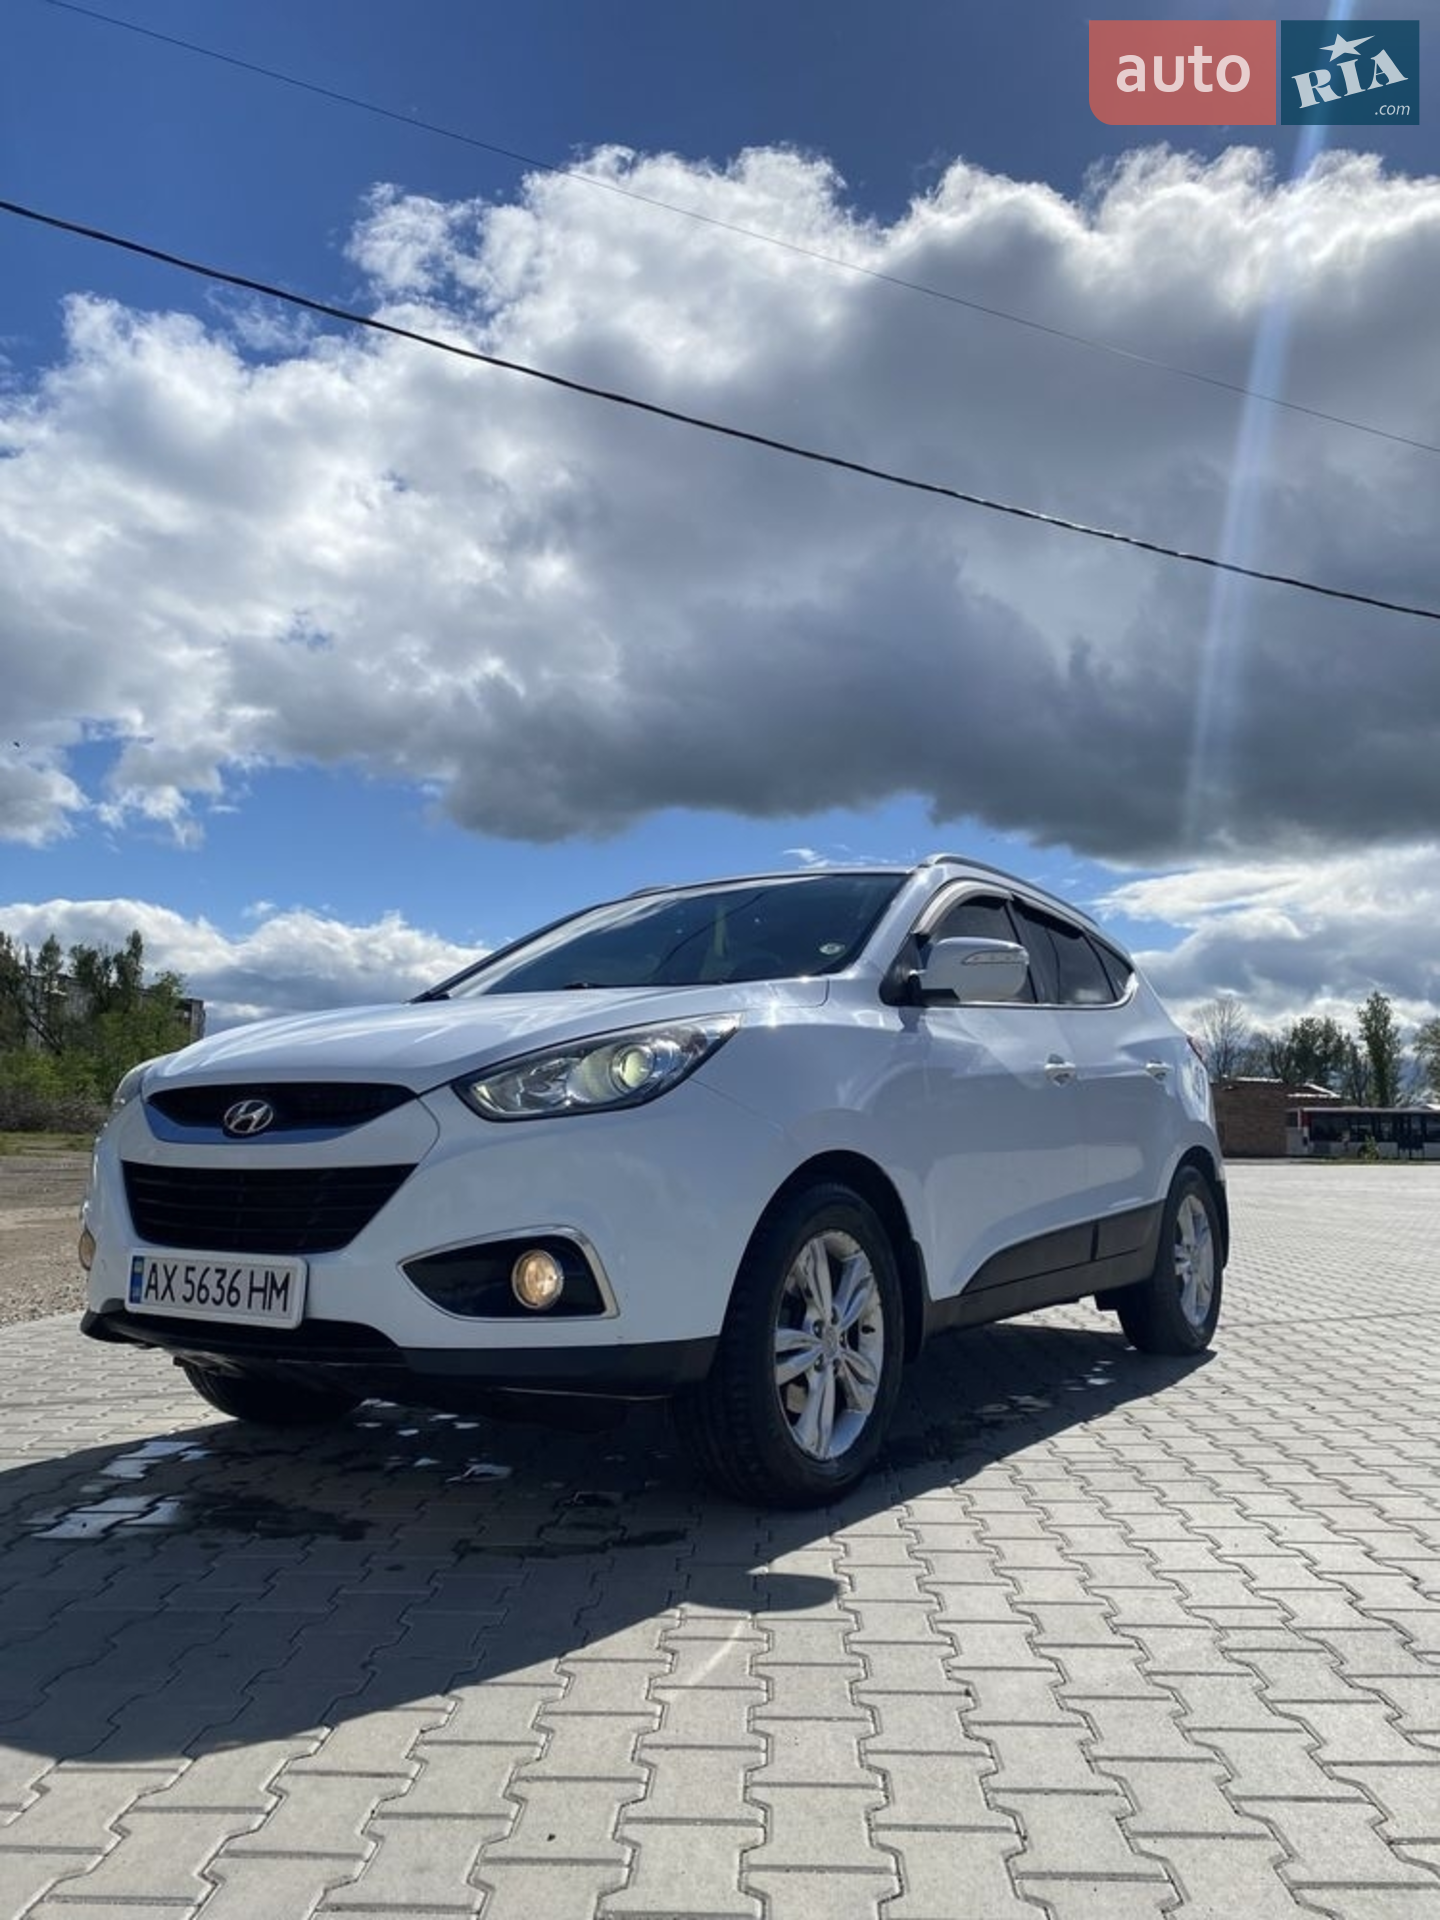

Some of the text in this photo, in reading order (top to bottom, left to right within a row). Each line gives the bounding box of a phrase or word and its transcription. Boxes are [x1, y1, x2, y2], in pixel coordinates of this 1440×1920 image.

[144, 1262, 291, 1312] AX 5636 HM
